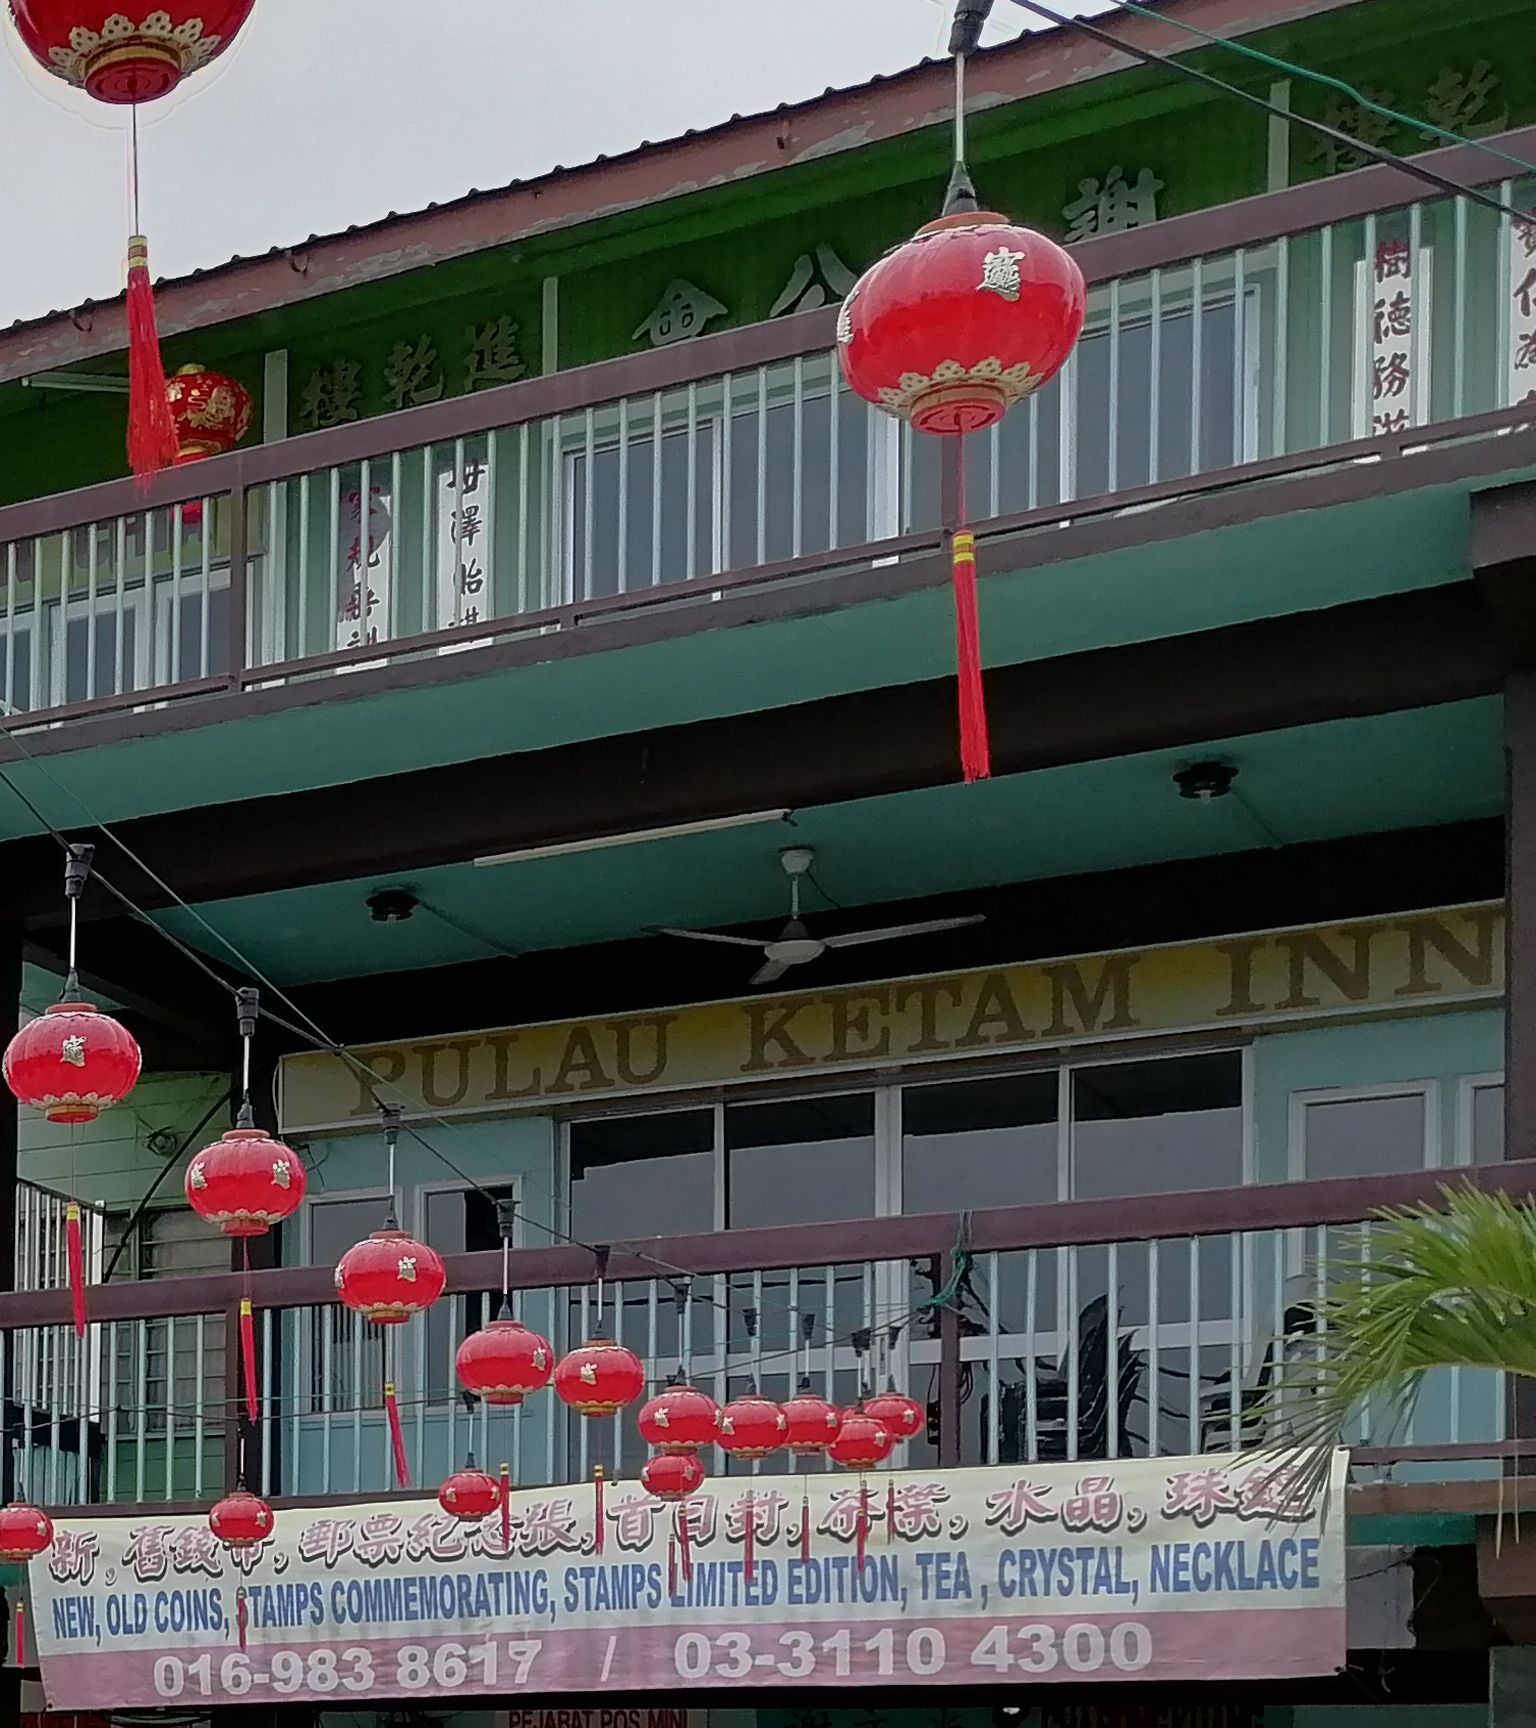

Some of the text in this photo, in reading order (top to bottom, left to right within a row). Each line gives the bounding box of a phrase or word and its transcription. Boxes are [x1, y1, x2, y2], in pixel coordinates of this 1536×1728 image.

[349, 905, 1497, 1119] PULAU KETAM INN
[52, 1596, 102, 1647] NEW,
[106, 1592, 149, 1638] OLD
[154, 1588, 229, 1642] COINS,
[331, 1570, 556, 1624] COMMEMORATING,
[563, 1564, 662, 1612] STAMPS
[669, 1555, 779, 1609] LIMITED
[787, 1552, 909, 1611] EDITION,
[997, 1544, 1139, 1605] CRYSTAL,
[1149, 1537, 1321, 1594] NECKLACE
[153, 1643, 375, 1697] 016-983
[397, 1637, 543, 1691] 8617
[673, 1625, 946, 1680] 03-3110
[971, 1620, 1154, 1674] 4300
